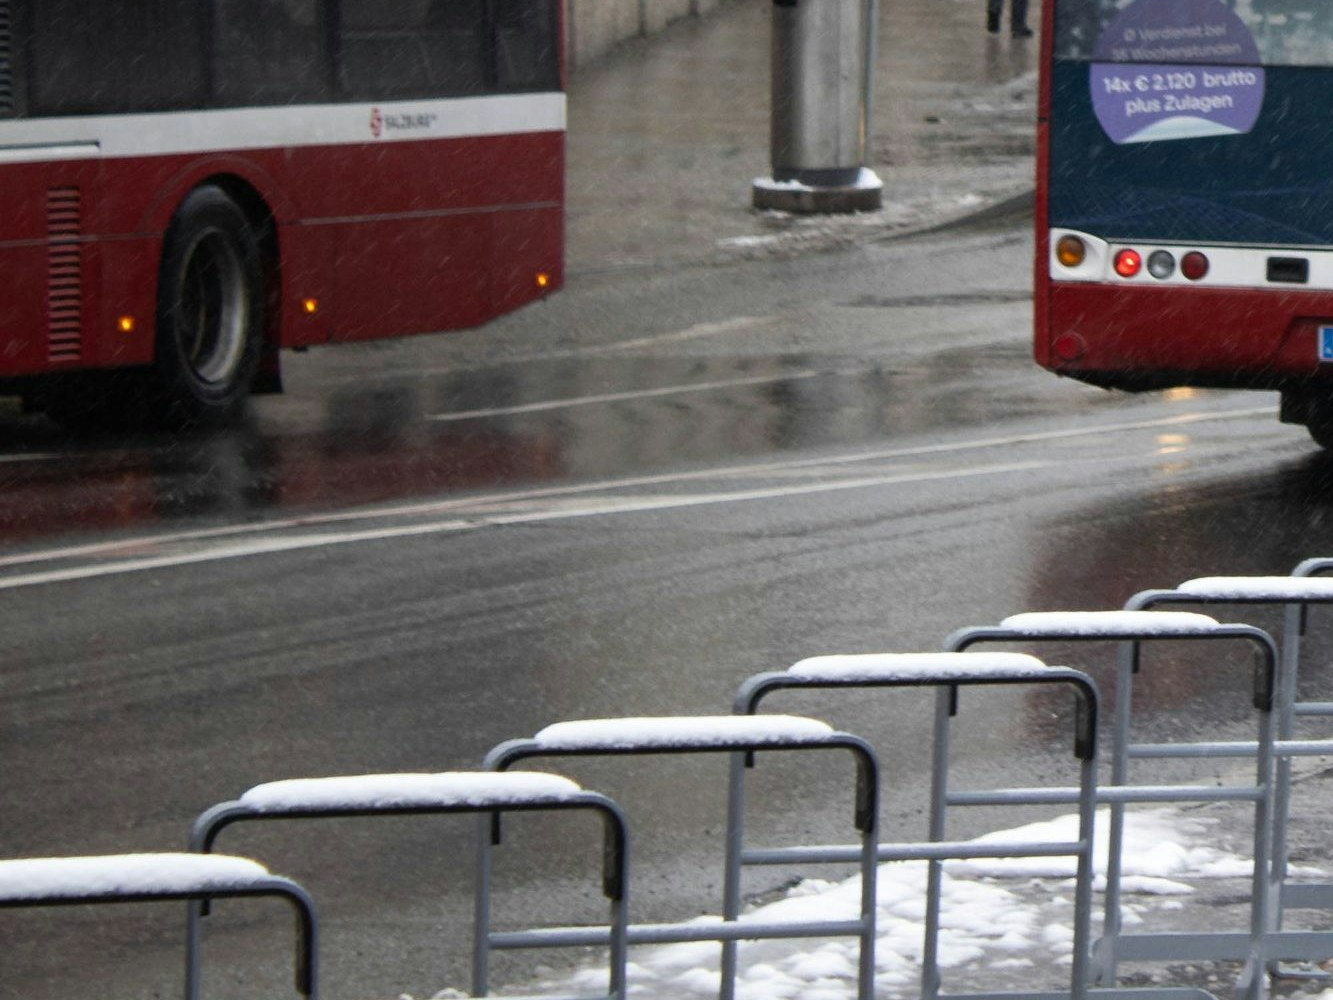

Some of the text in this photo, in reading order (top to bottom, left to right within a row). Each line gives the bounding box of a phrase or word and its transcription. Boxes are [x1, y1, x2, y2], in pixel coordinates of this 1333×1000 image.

[1203, 23, 1227, 37] bei
[1103, 76, 1131, 94] 14x
[1134, 75, 1149, 92] €
[1203, 70, 1257, 88] brutto
[1125, 94, 1234, 117] plus Zulagen
